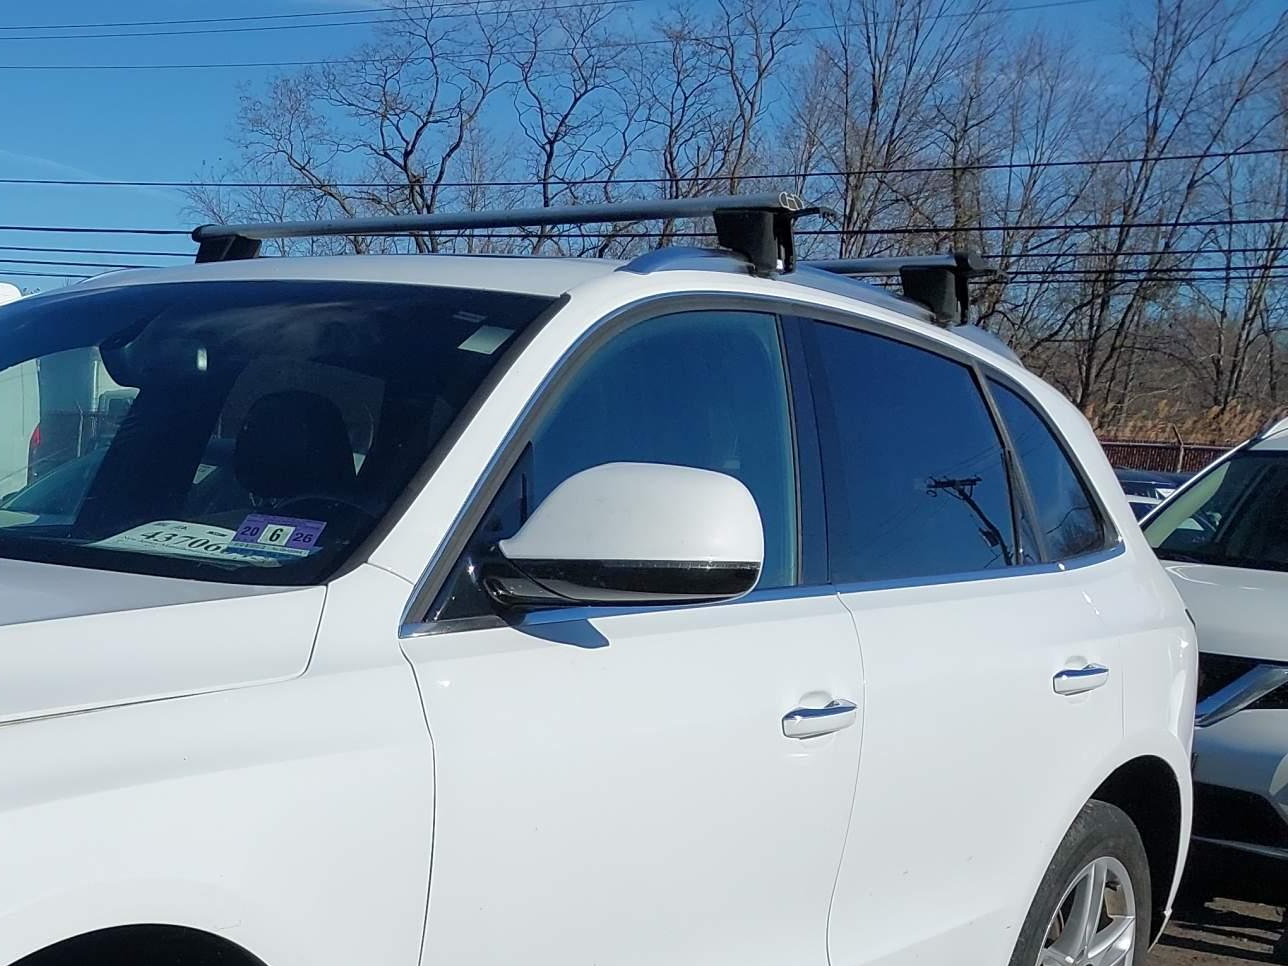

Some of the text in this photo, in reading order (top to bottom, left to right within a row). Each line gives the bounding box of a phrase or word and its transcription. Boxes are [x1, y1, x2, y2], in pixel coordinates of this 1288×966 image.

[141, 531, 225, 553] 43706
[241, 526, 314, 543] 20 6 26
